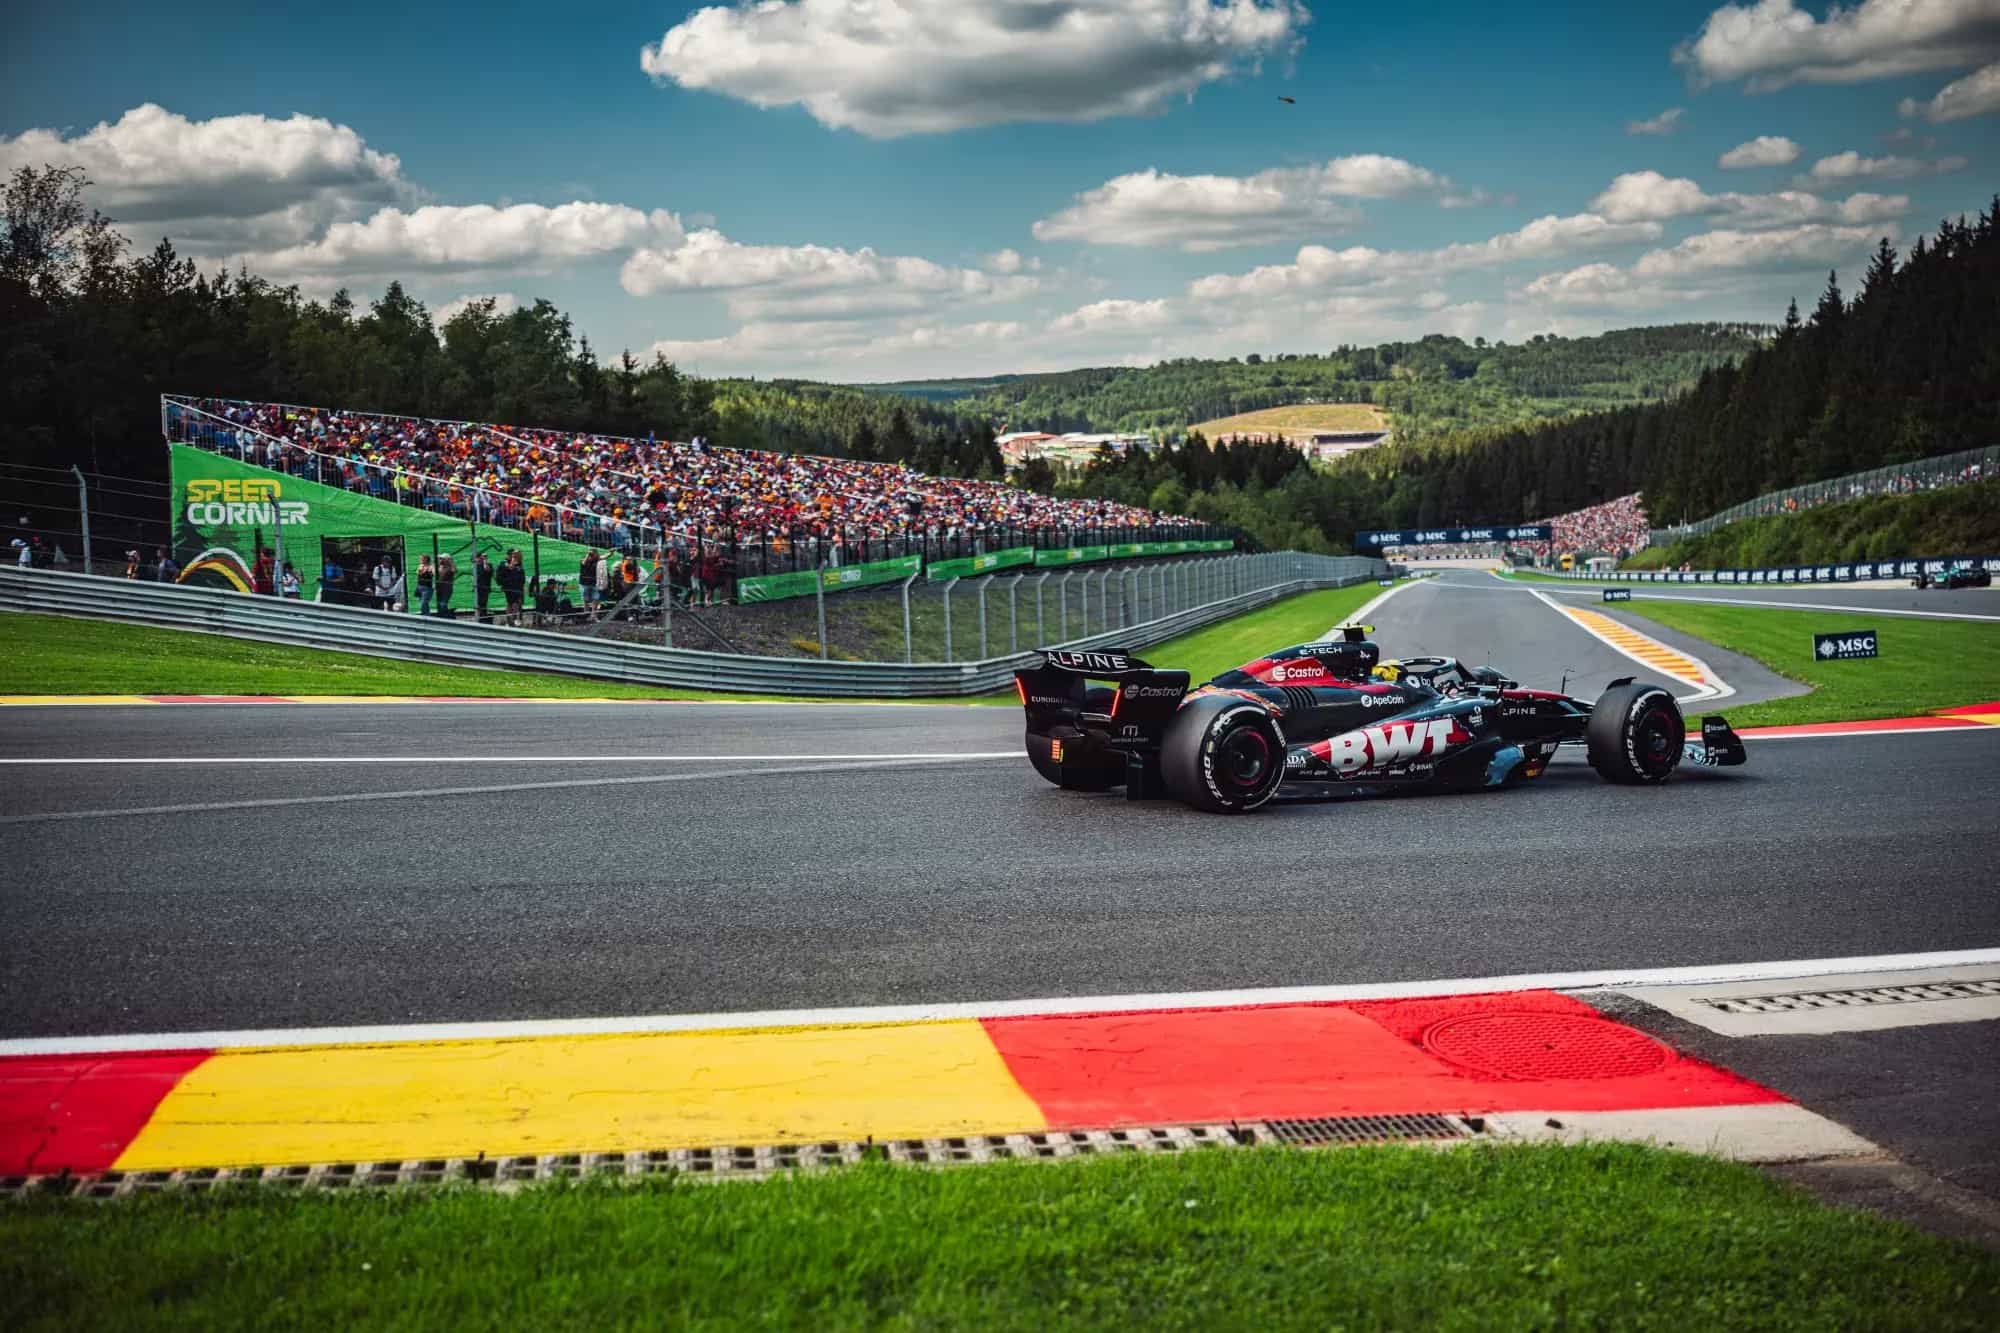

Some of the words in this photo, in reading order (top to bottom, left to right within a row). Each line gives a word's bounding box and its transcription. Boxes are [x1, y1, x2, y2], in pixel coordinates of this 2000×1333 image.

[186, 479, 281, 502] SPEED
[187, 501, 309, 525] CORNER
[1299, 647, 1343, 655] E-TECH
[1838, 637, 1875, 652] MSC
[1048, 652, 1129, 669] ALPINE
[1287, 667, 1325, 678] Castrol
[1139, 686, 1183, 698] Castrol
[1373, 695, 1404, 705] ApeCoin
[1329, 718, 1454, 773] BWT
